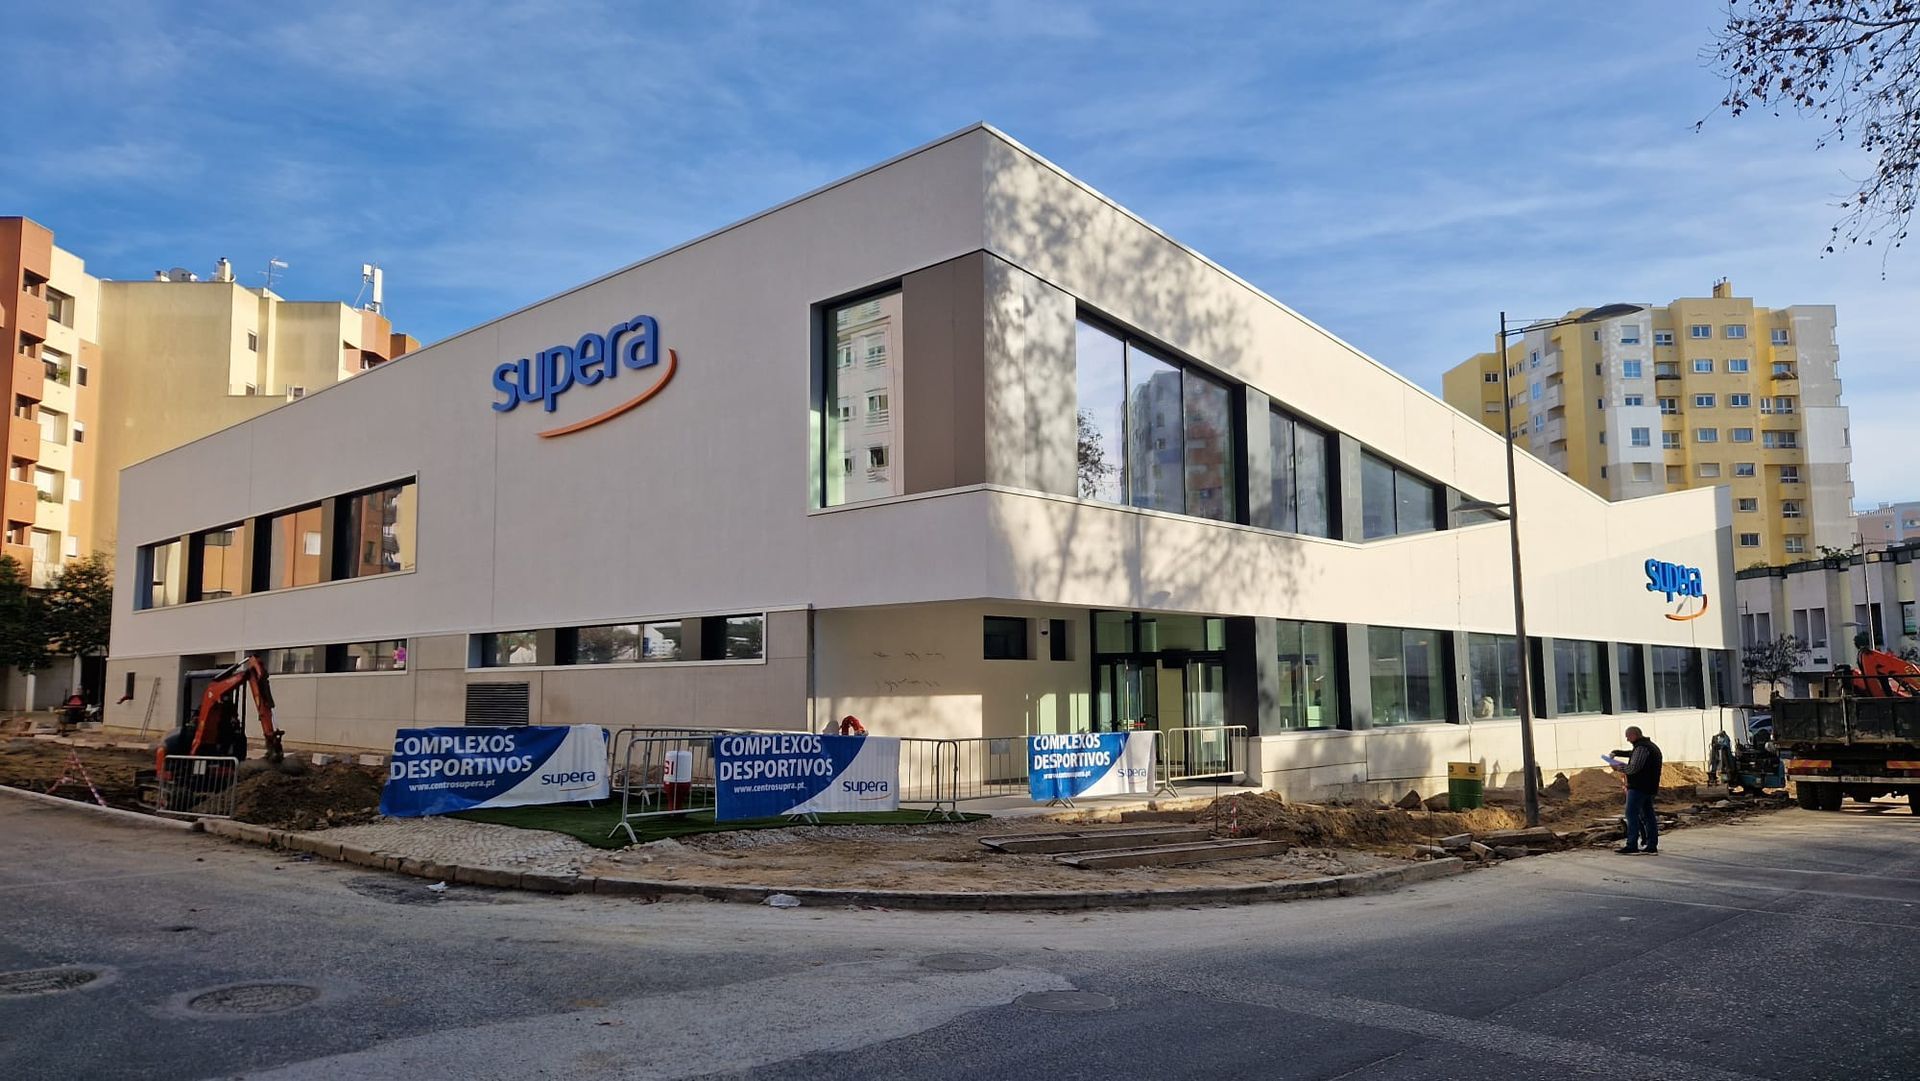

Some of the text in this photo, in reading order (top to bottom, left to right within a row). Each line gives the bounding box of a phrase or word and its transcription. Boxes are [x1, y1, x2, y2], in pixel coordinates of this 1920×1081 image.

[492, 314, 659, 412] supera
[1645, 559, 1703, 603] supera
[393, 734, 515, 756] COMPLEXOS
[720, 735, 821, 757] COMPLEXOS
[1033, 733, 1101, 751] COMPLEXOS
[390, 755, 532, 780] DESPORTIVOS
[720, 758, 833, 781] DESPORTIVOS
[1034, 751, 1111, 770] DESPORTIVOS
[408, 779, 496, 792] www.centrosupera.pt
[541, 770, 596, 786] supera
[843, 780, 888, 795] supera
